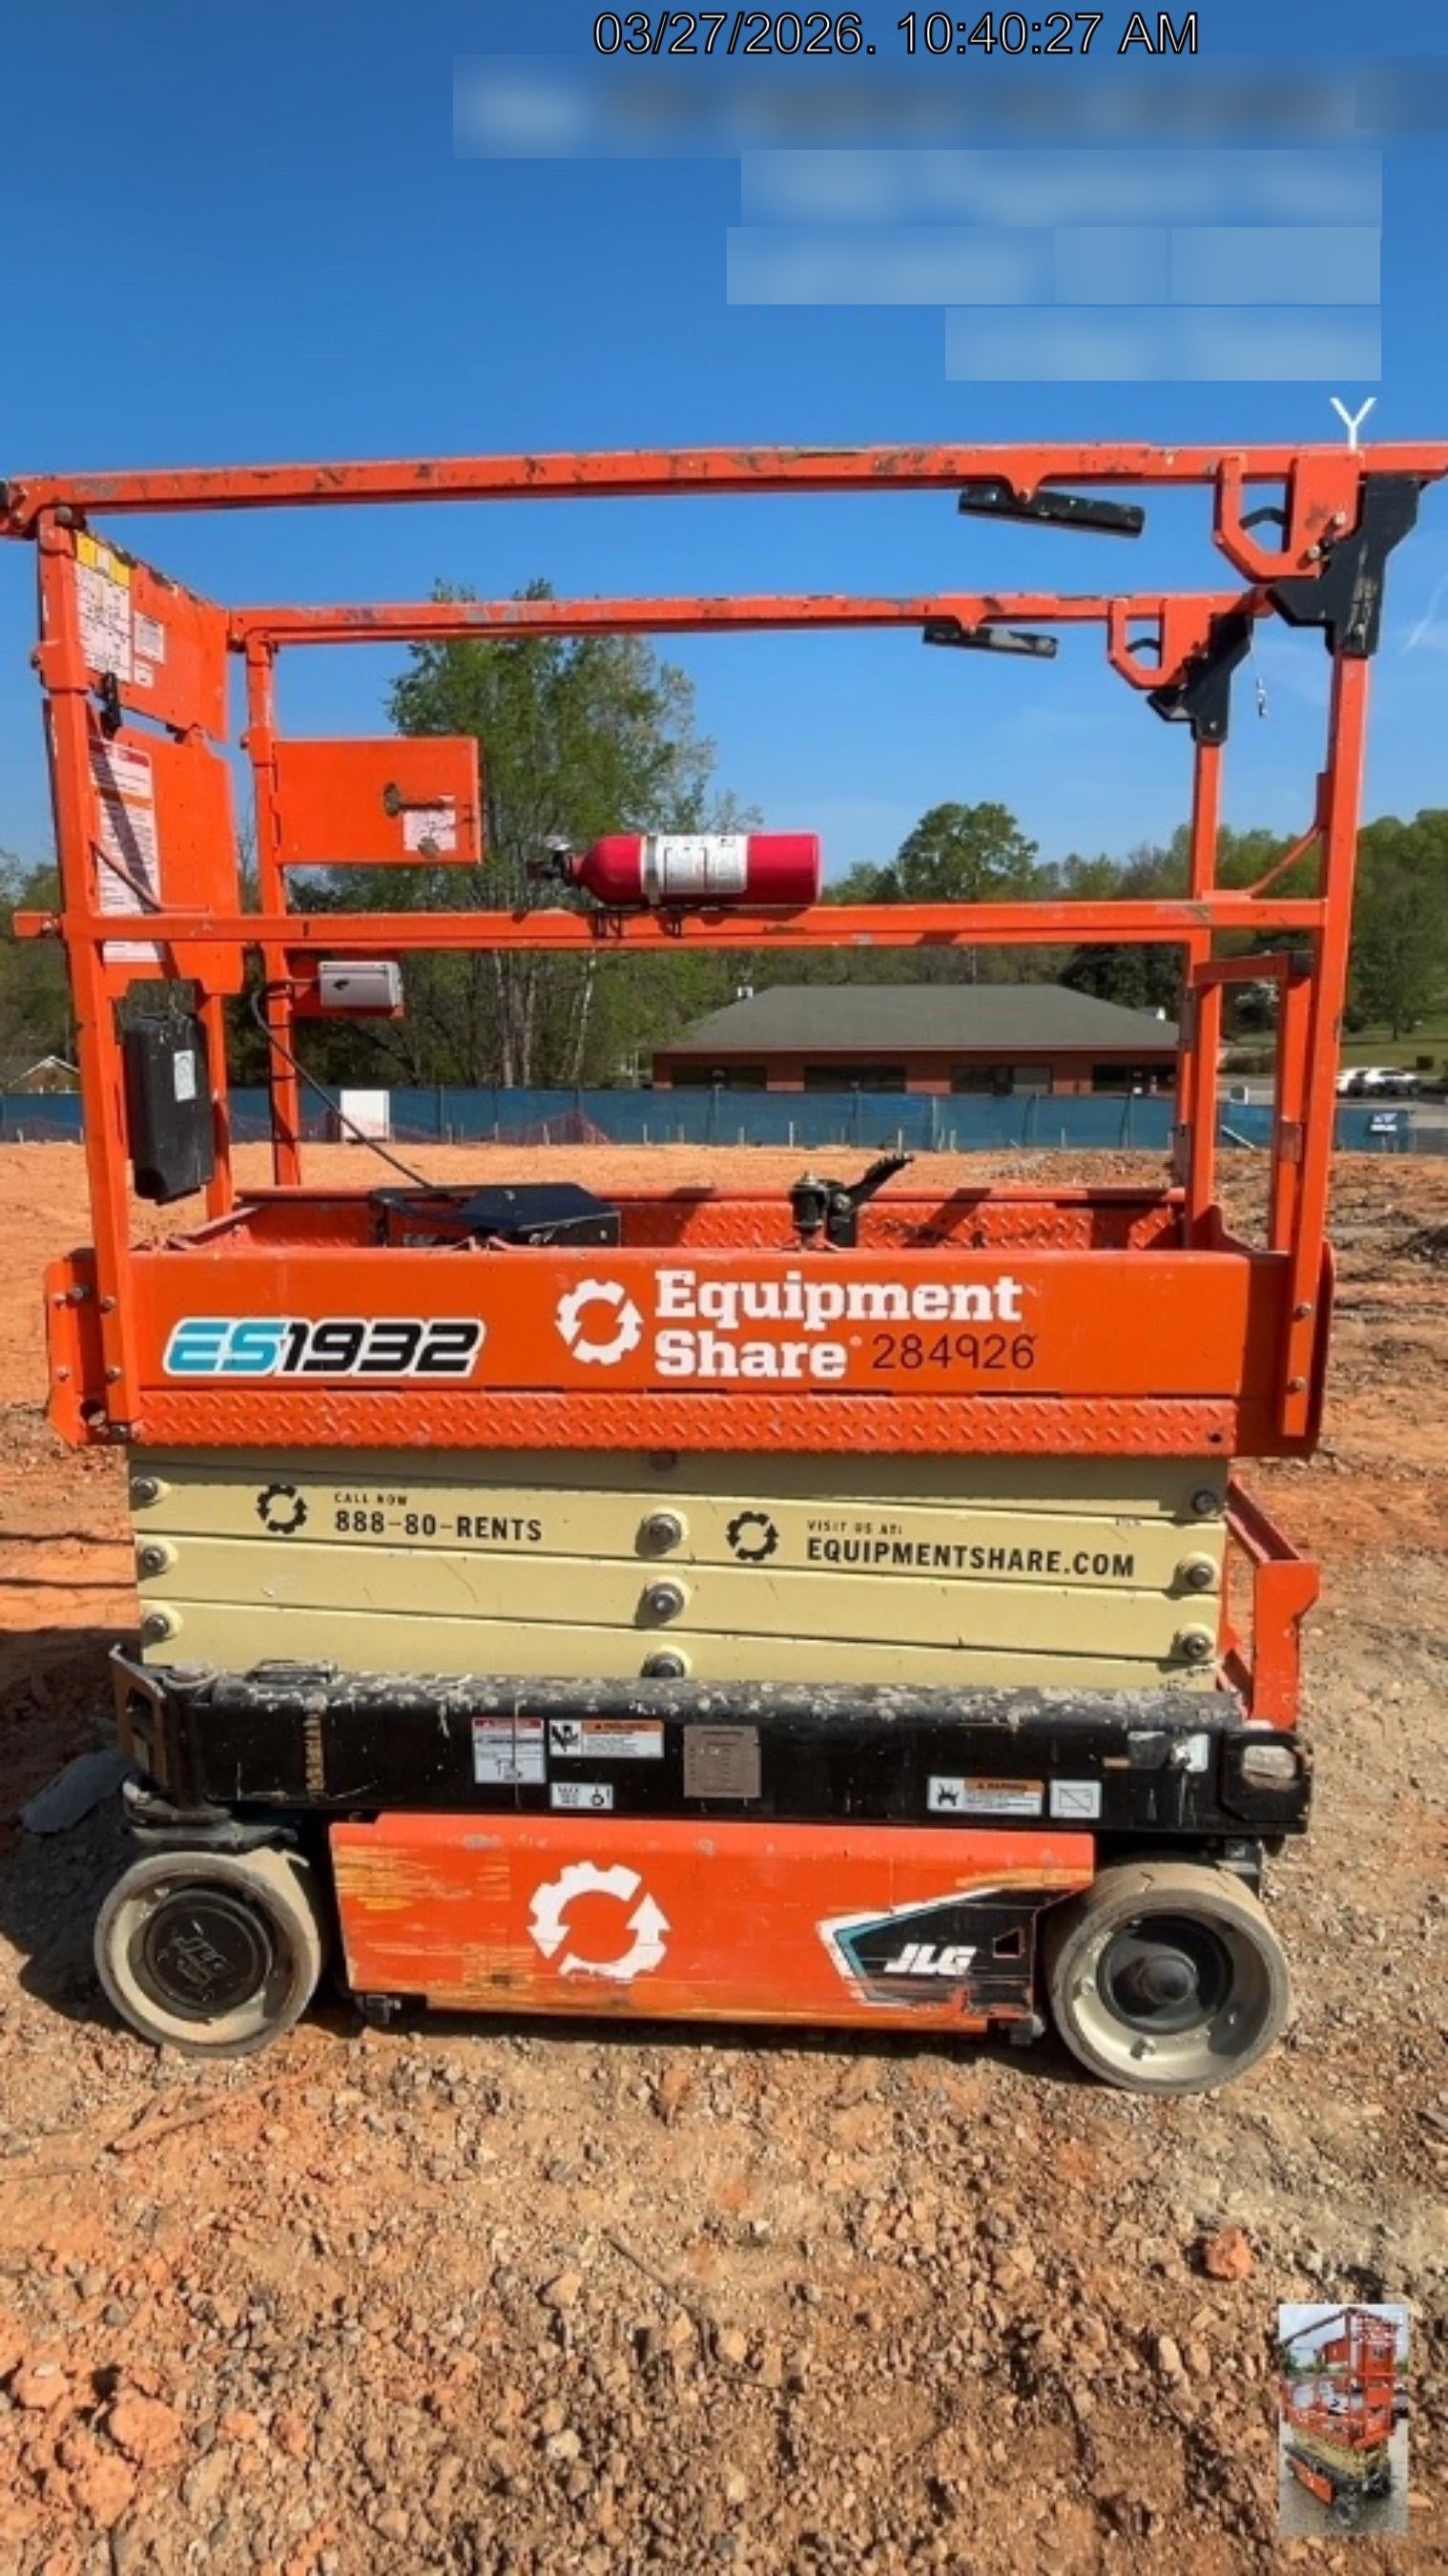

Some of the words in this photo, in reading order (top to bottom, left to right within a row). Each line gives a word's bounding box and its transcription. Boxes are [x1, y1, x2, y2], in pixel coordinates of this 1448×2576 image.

[654, 1270, 1024, 1331] Equipment
[167, 1320, 482, 1375] ES1932
[870, 1333, 1039, 1370] 284926
[334, 1490, 368, 1505] CALL
[376, 1493, 408, 1506] NOW
[334, 1509, 543, 1542] 888-80-RENTS
[807, 1519, 848, 1532] VISIT
[854, 1521, 872, 1534] US
[806, 1536, 1135, 1578] EQUIPMENTSHARE.COM
[883, 1942, 979, 1977] JLG
